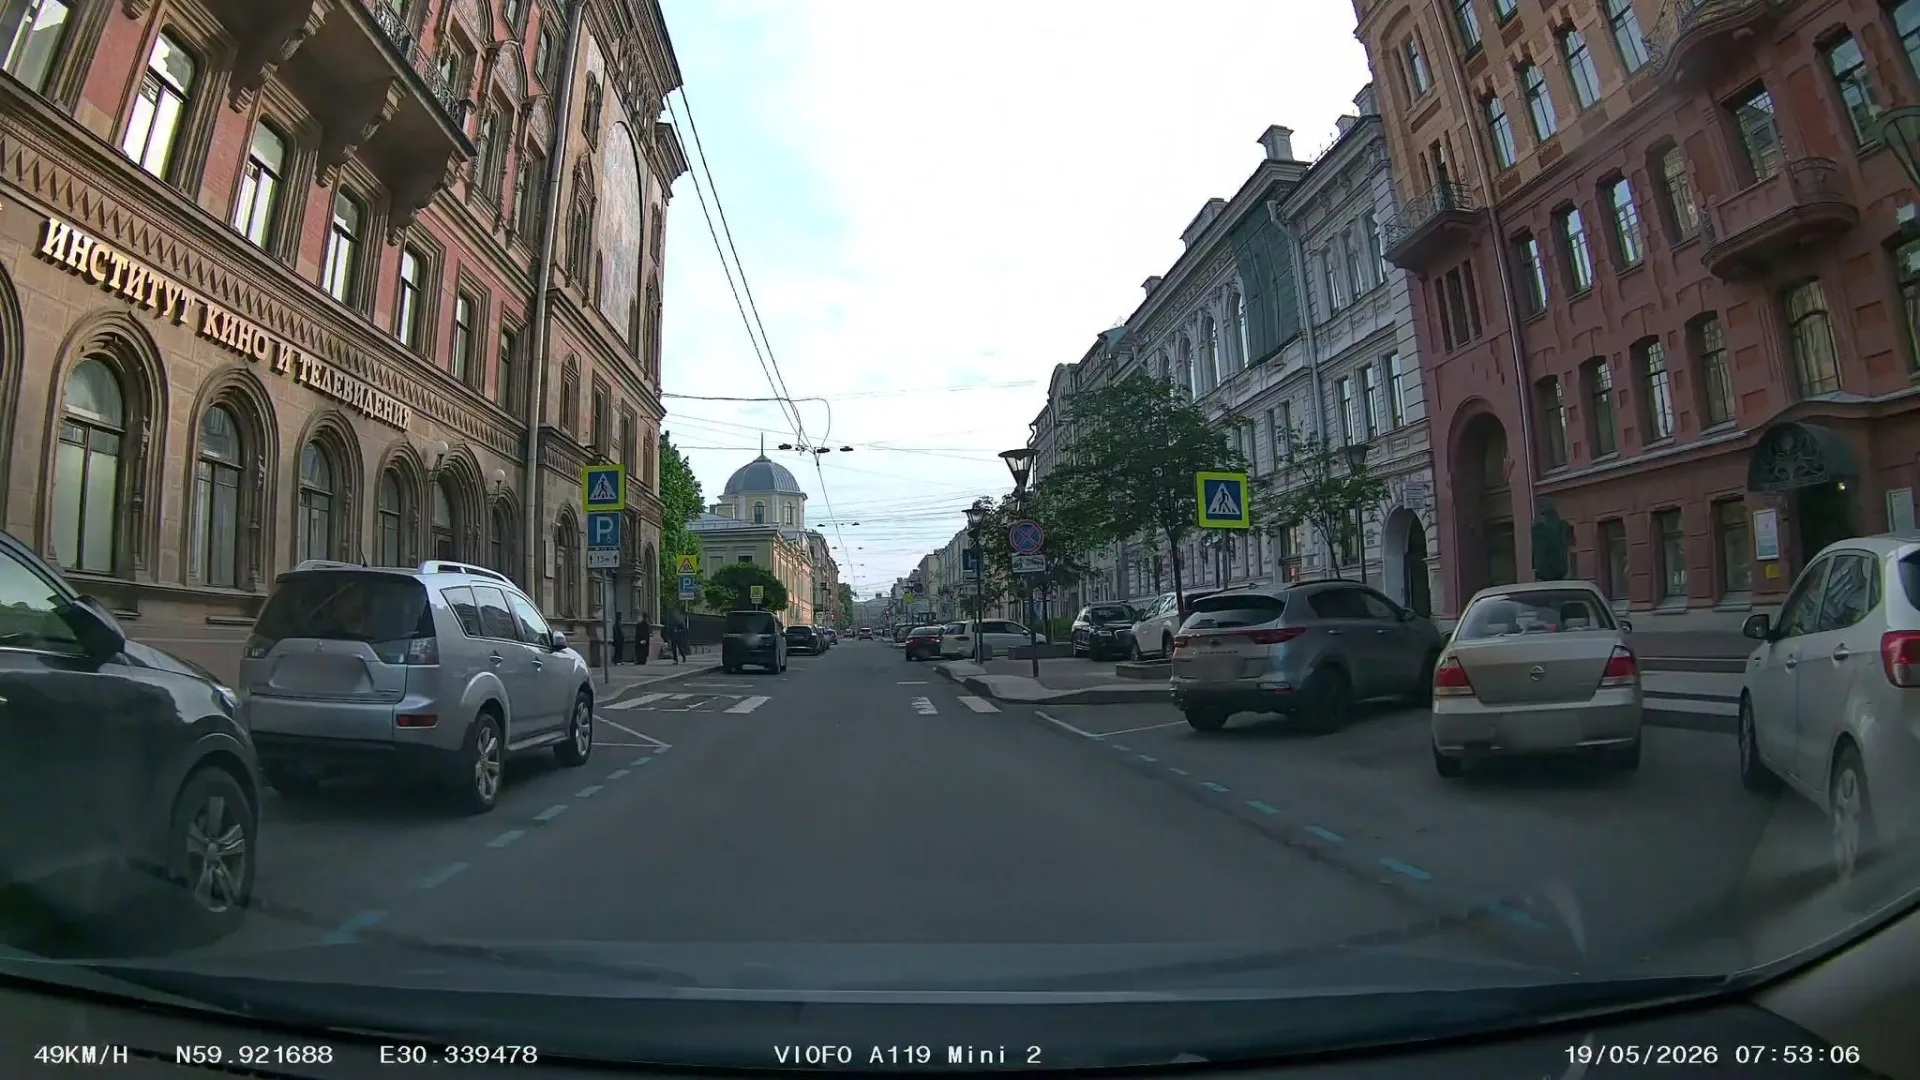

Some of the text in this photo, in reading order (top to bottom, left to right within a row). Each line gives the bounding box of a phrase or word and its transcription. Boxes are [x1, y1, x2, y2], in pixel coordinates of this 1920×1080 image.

[41, 216, 413, 432] ИНСТИТУТ КИНО И ТЕЛЕВИДЕНИЯ
[596, 516, 614, 544] P
